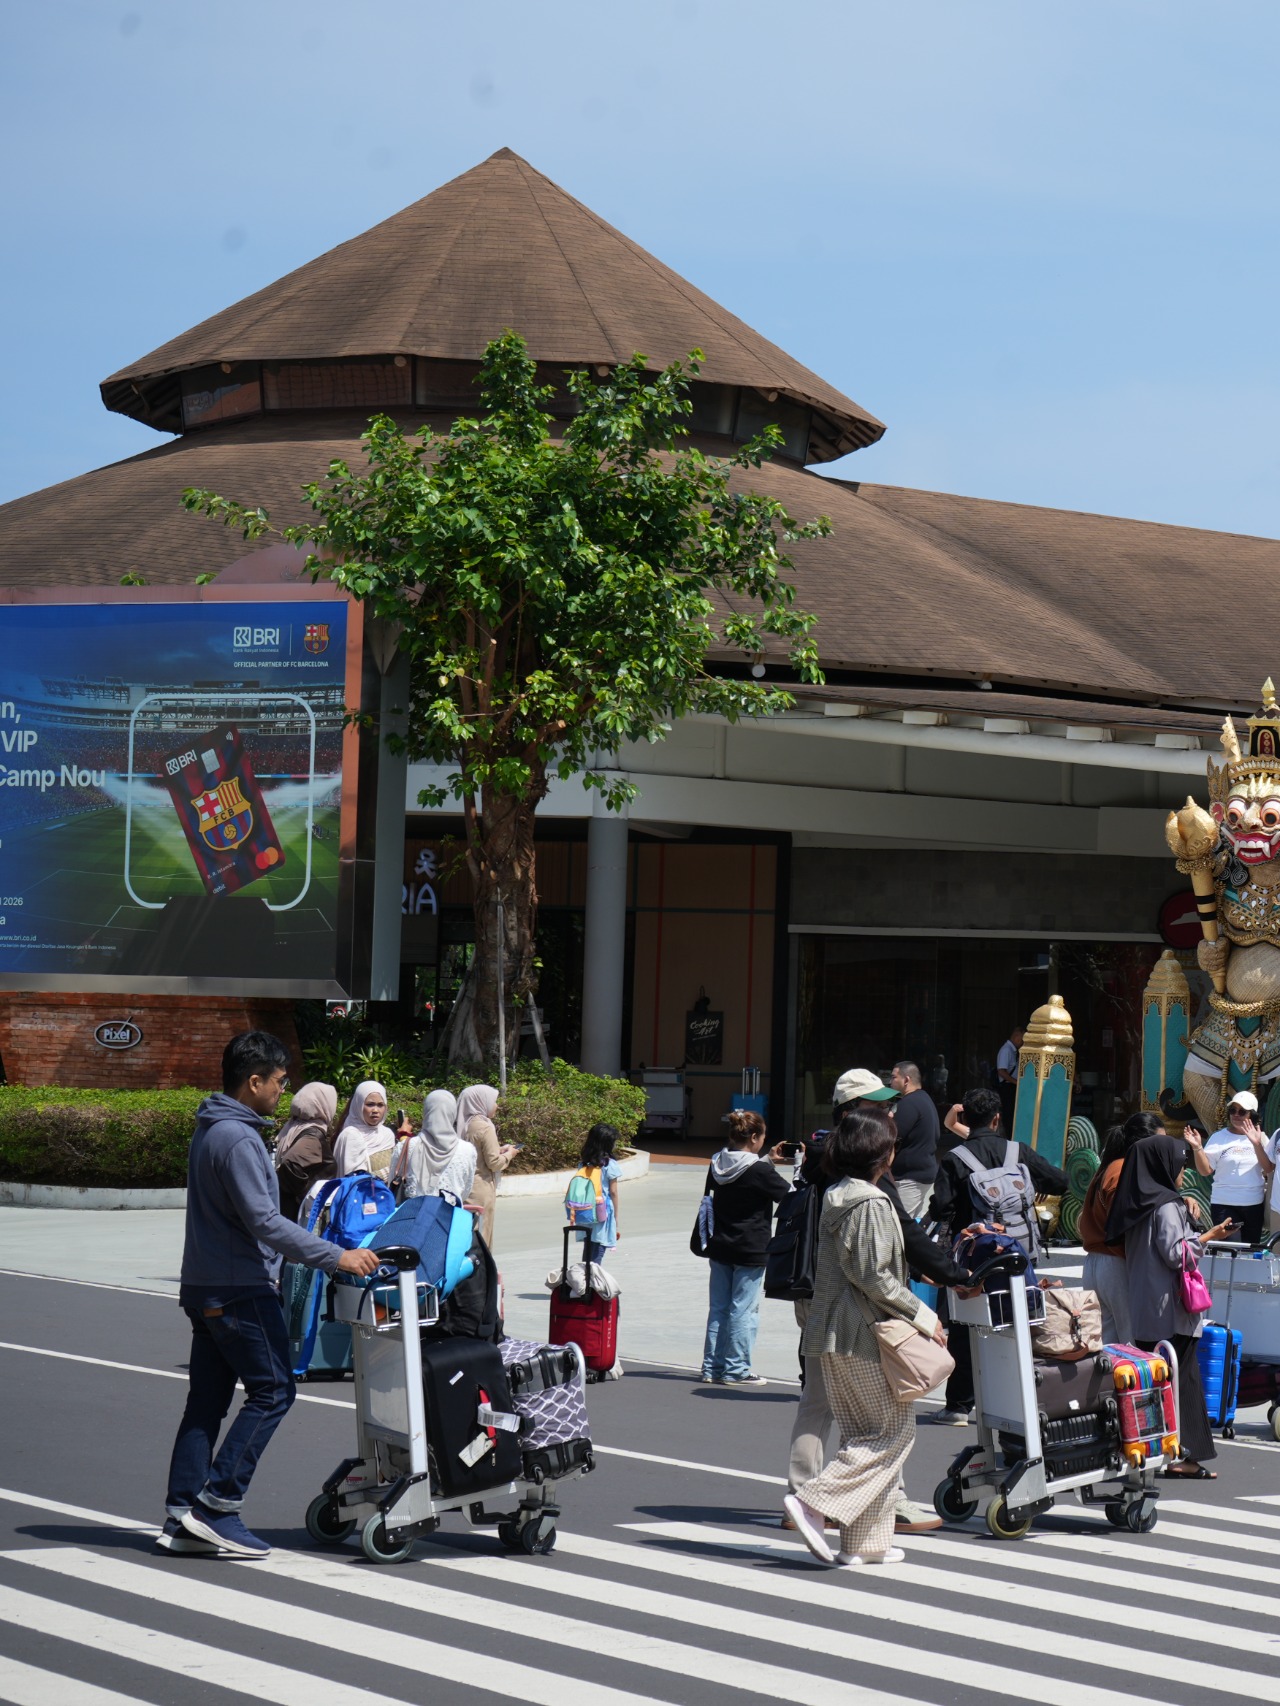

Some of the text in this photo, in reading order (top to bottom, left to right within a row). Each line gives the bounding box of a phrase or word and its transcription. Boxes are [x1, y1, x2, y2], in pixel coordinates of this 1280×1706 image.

[253, 628, 280, 646] BRI
[0, 730, 38, 753] VIP
[178, 749, 198, 769] BRI
[60, 764, 106, 787] Nou
[213, 810, 235, 825] FCB
[3, 896, 24, 907] 2026
[104, 1027, 130, 1041] Pixel
